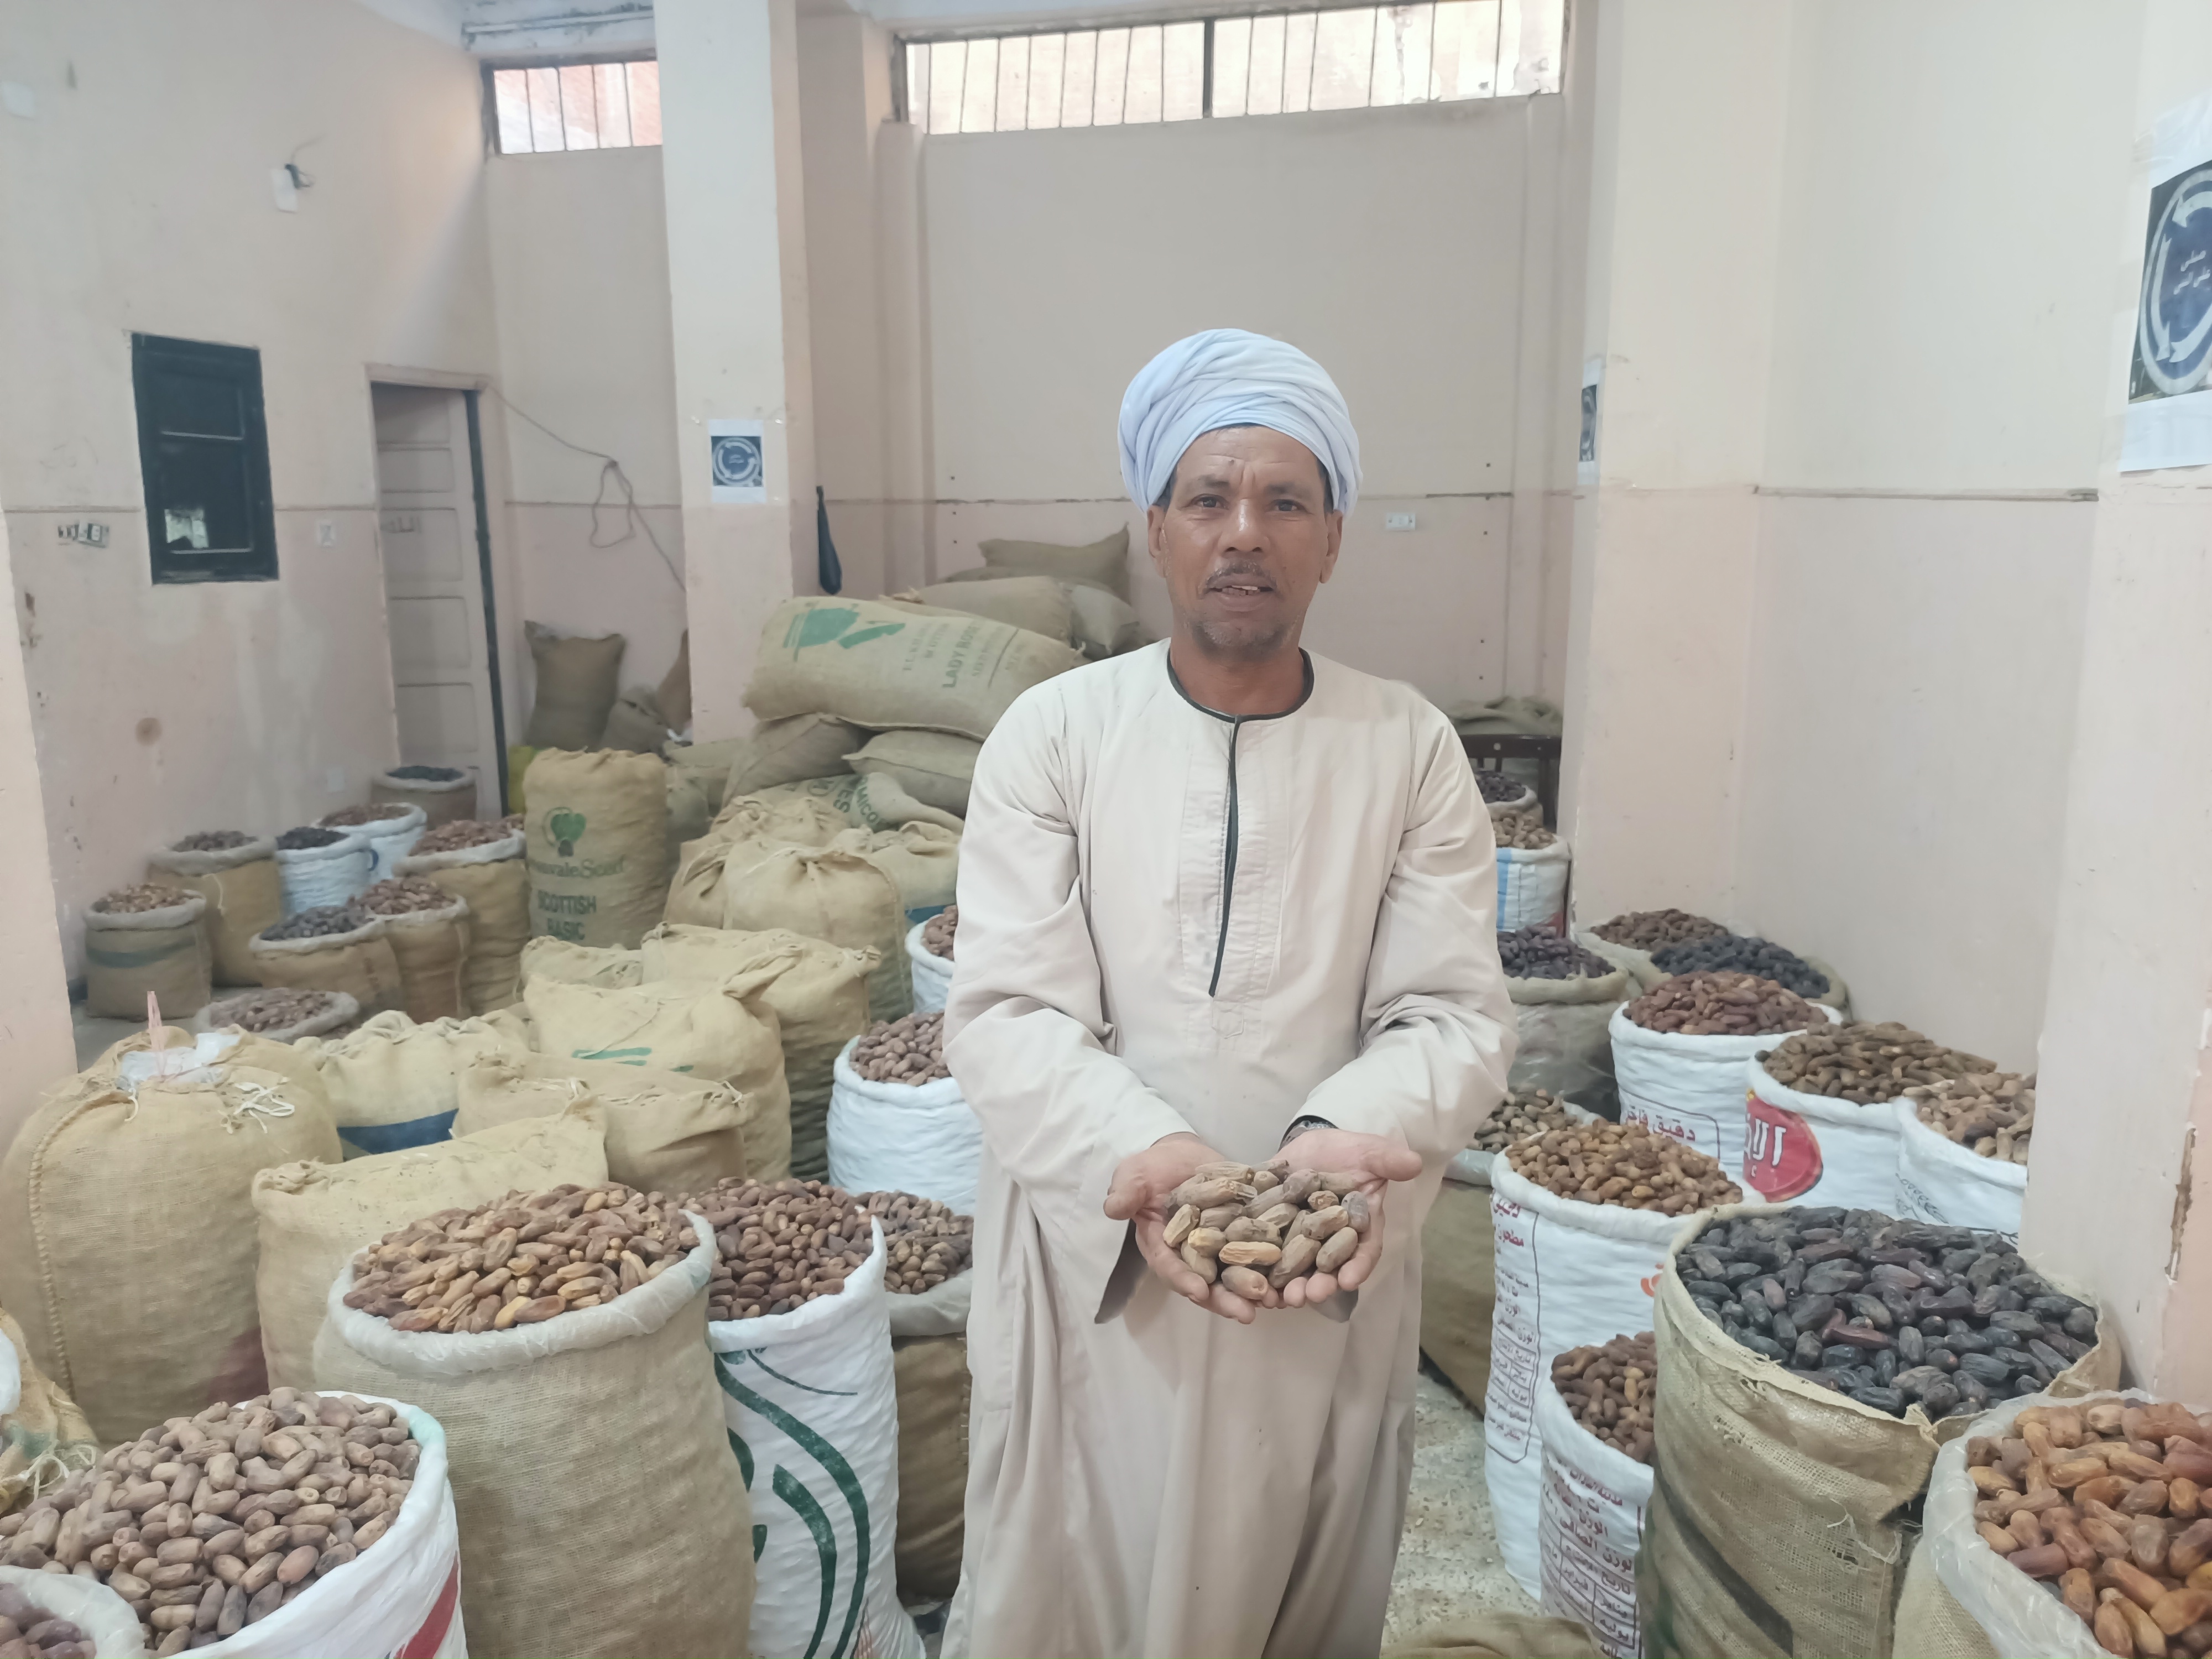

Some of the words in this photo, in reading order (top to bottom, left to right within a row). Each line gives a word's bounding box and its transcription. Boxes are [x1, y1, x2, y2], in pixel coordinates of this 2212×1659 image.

[538, 889, 597, 914] SCOTTISH
[1652, 1114, 1695, 1142] دقيق
[1603, 1547, 1632, 1572] لوزن
